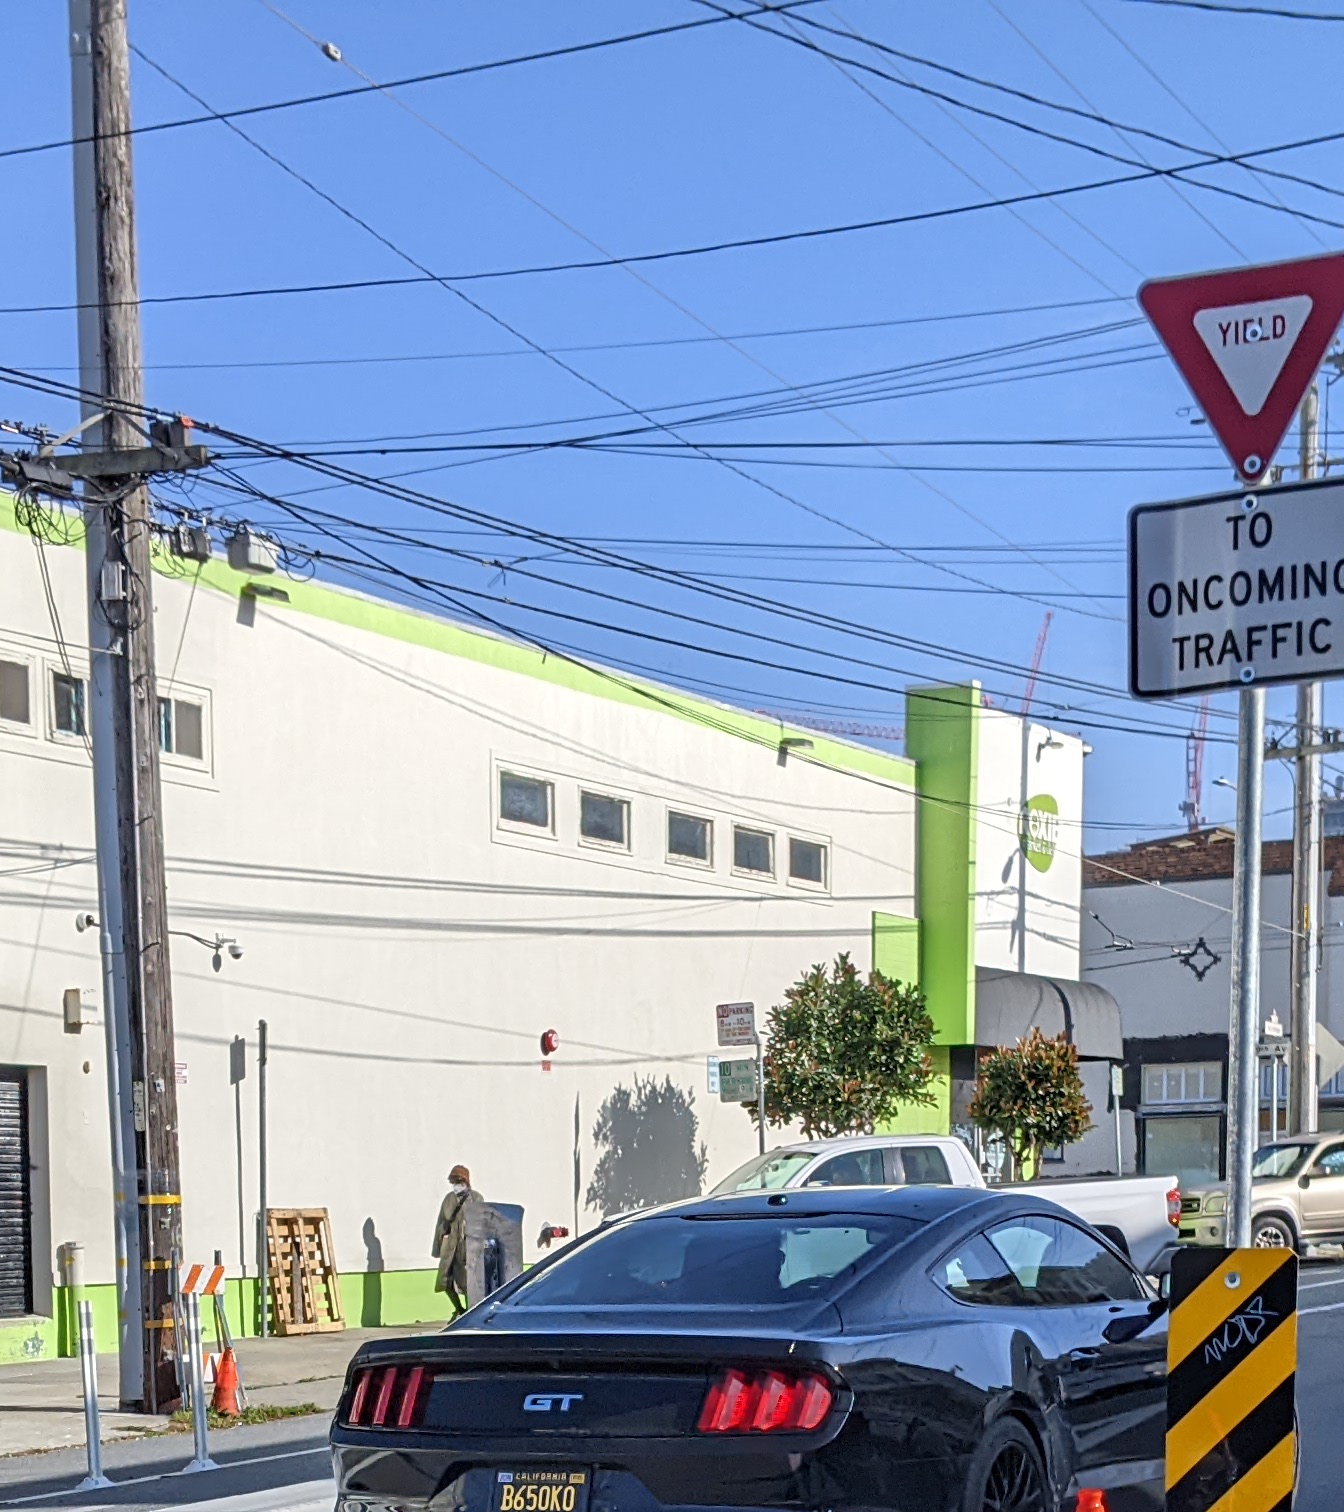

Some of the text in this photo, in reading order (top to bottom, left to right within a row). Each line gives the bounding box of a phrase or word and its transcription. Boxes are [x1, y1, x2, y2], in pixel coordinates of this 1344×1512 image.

[1218, 314, 1287, 348] YIELD
[1226, 511, 1273, 551] TO
[1172, 617, 1332, 672] TRAFFIC
[720, 1062, 731, 1076] 10
[523, 1394, 584, 1411] GT
[515, 1472, 567, 1480] CALIFORNIA
